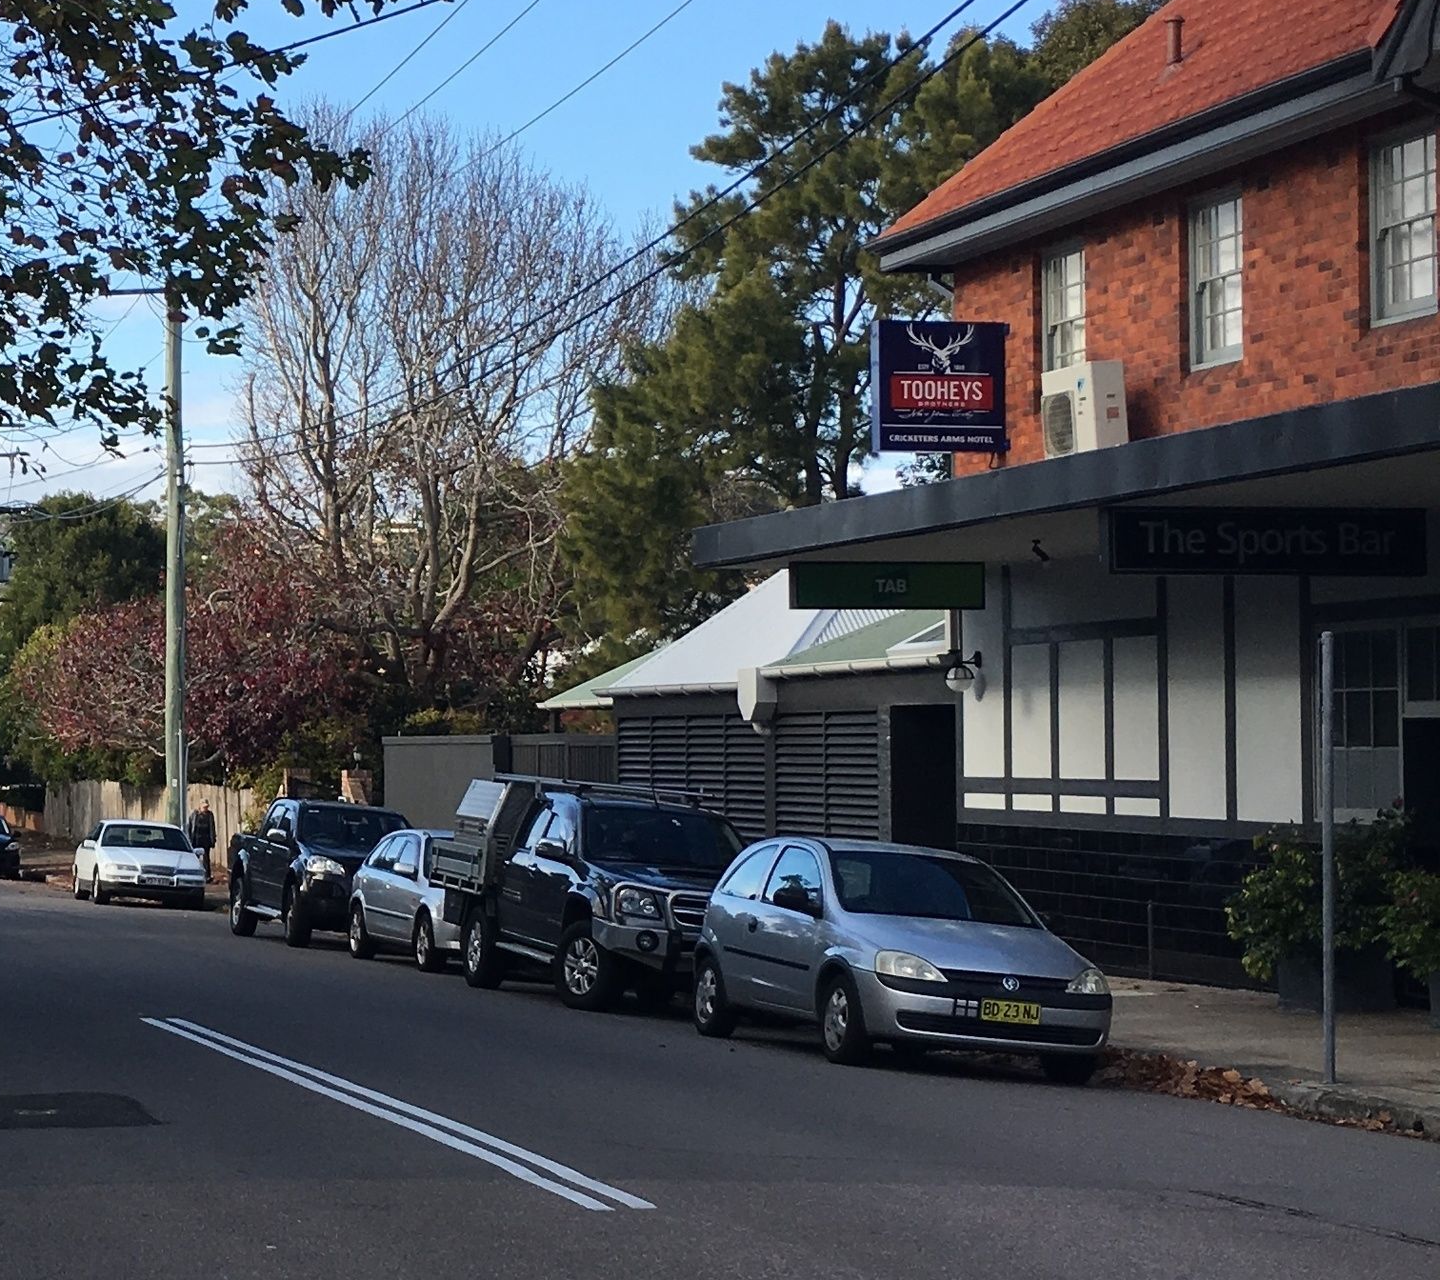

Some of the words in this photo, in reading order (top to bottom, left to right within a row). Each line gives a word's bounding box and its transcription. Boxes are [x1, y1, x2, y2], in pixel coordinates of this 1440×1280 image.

[899, 380, 983, 401] TOOHEYS
[888, 434, 939, 443] CRICKETERS
[940, 435, 965, 444] ARMS
[967, 436, 994, 444] HOTEL
[1138, 518, 1206, 554] The
[1216, 521, 1328, 564] Sports
[1338, 523, 1396, 556] Bar
[875, 578, 907, 594] TAB
[983, 1001, 1000, 1017] BD
[1003, 1003, 1020, 1019] 23
[1022, 1005, 1040, 1020] NJ
